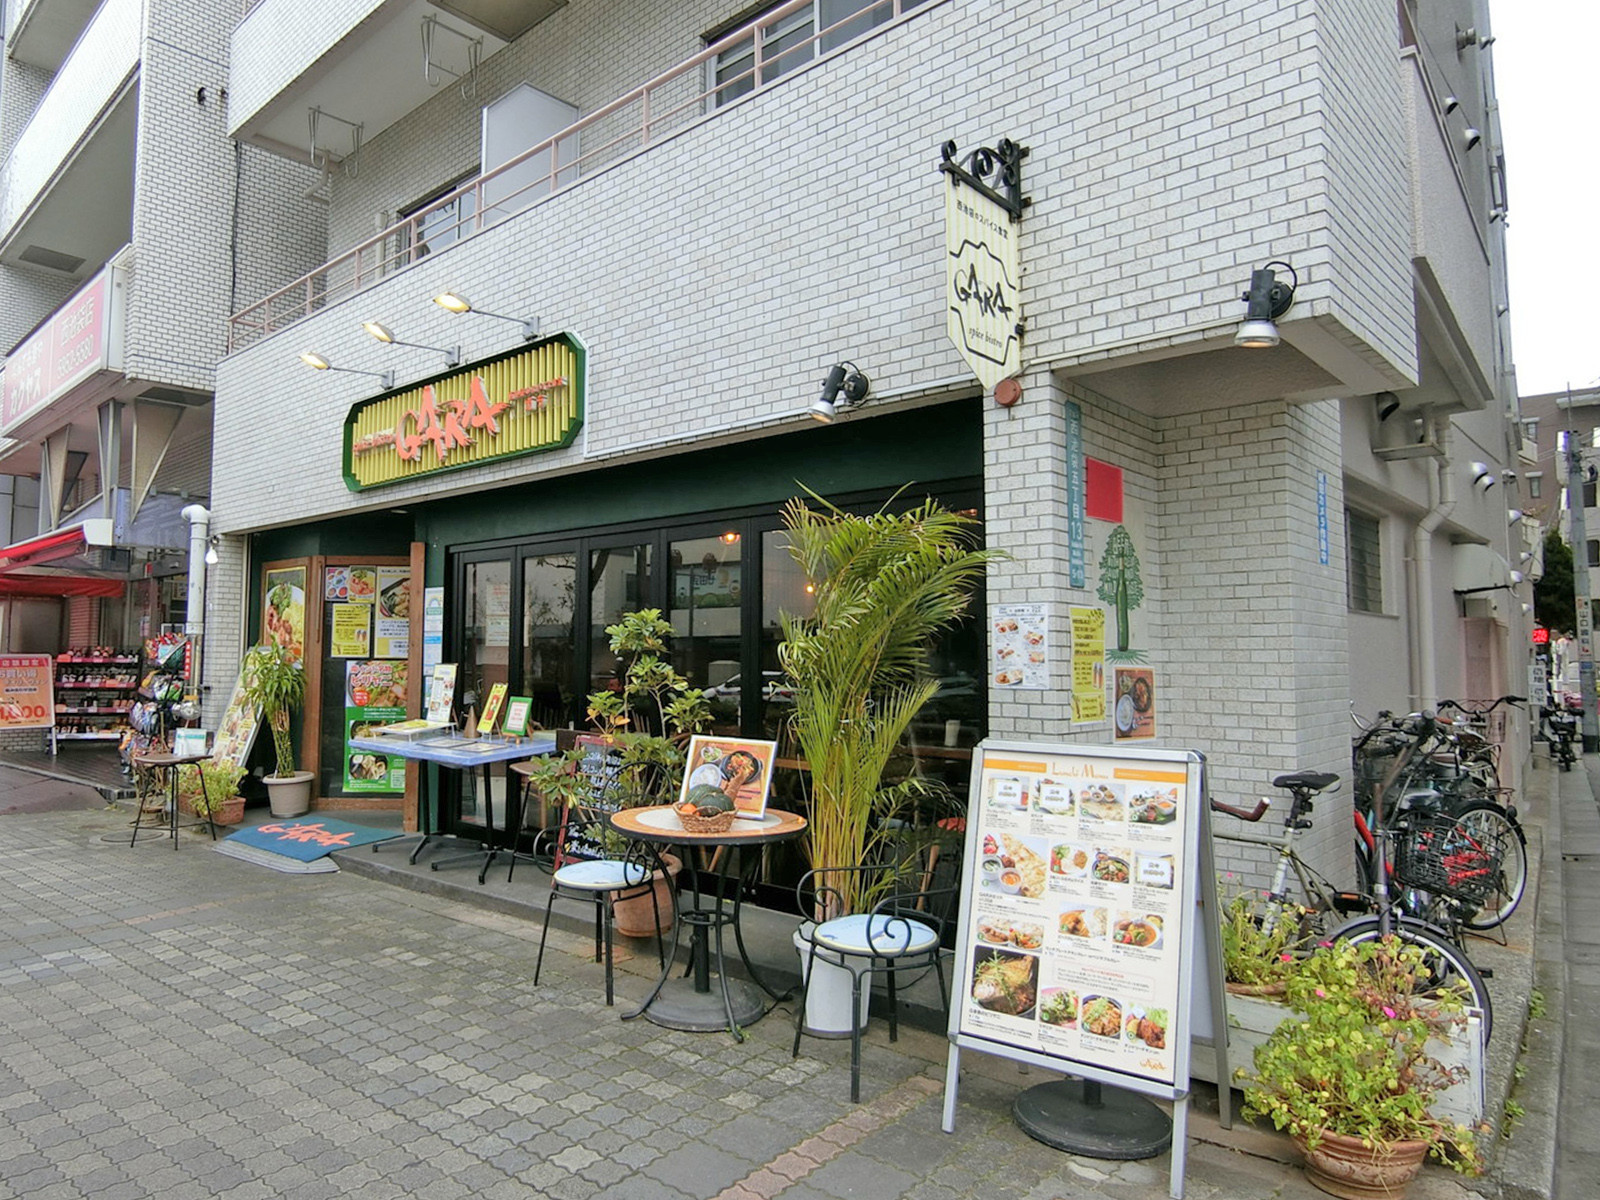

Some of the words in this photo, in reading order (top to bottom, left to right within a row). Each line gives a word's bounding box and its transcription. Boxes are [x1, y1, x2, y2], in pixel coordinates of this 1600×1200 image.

[954, 263, 1013, 322] GARA
[969, 328, 984, 340] spice
[985, 331, 1002, 347] bistro
[396, 375, 511, 461] GARA
[258, 823, 355, 847] GARA
